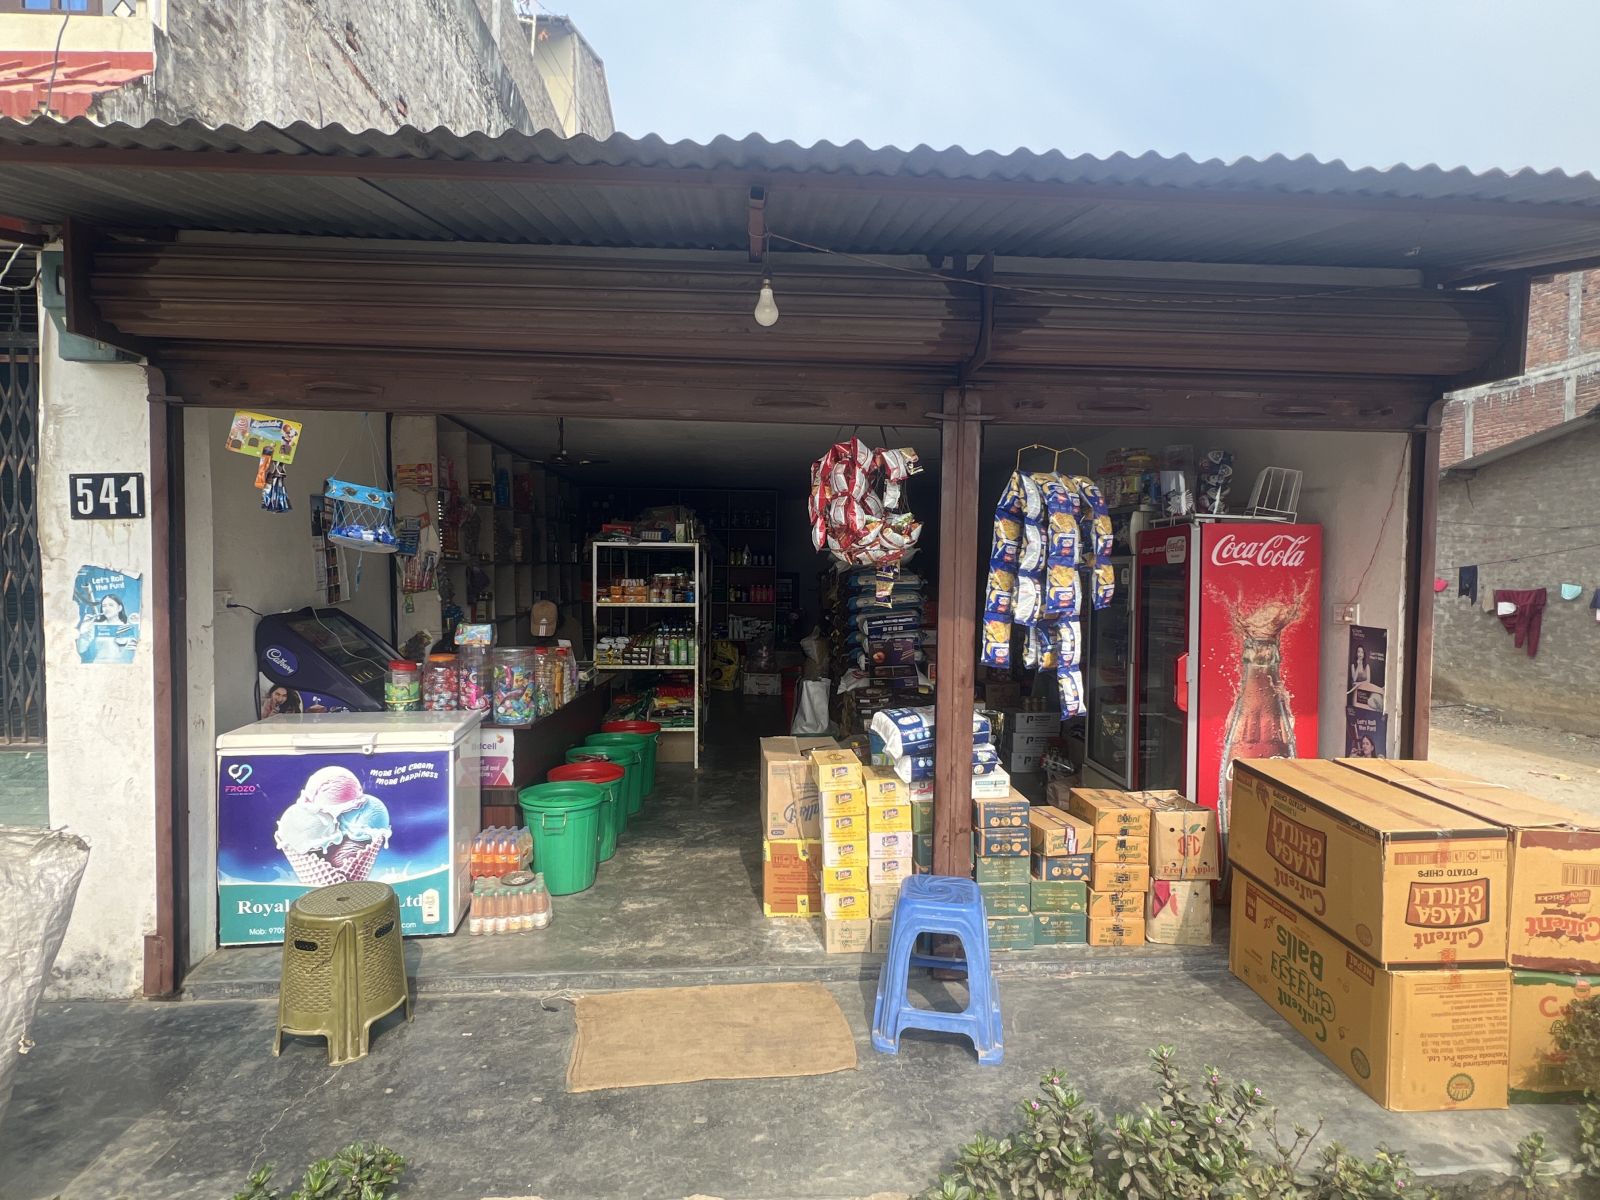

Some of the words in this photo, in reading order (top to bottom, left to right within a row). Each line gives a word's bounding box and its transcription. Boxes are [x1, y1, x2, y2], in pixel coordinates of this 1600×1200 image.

[77, 476, 138, 514] 541
[1211, 534, 1312, 567] Coca-Cola
[110, 574, 124, 582] Roll
[266, 648, 294, 674] Cadbury
[393, 765, 407, 775] ice
[399, 770, 439, 783] happiness
[224, 785, 256, 793] FROZO
[1271, 814, 1322, 858] CHILLI
[1272, 837, 1320, 878] NAGA
[1192, 865, 1216, 874] Apple
[1417, 869, 1444, 878] CHIPS
[1447, 868, 1478, 877] POTATO
[1273, 867, 1327, 917] Current
[1413, 885, 1484, 906] CHILLI
[236, 899, 290, 917] Royal
[1416, 903, 1482, 925] NAGA
[248, 927, 267, 936] Mob:
[1413, 927, 1484, 950] Current
[1525, 917, 1600, 942] Current
[1276, 925, 1324, 982] Balls
[1277, 986, 1328, 1042] Current
[1456, 1053, 1478, 1061] Foods
[1462, 1059, 1508, 1068] Manufactured
[1479, 1051, 1508, 1059] Yashoda
